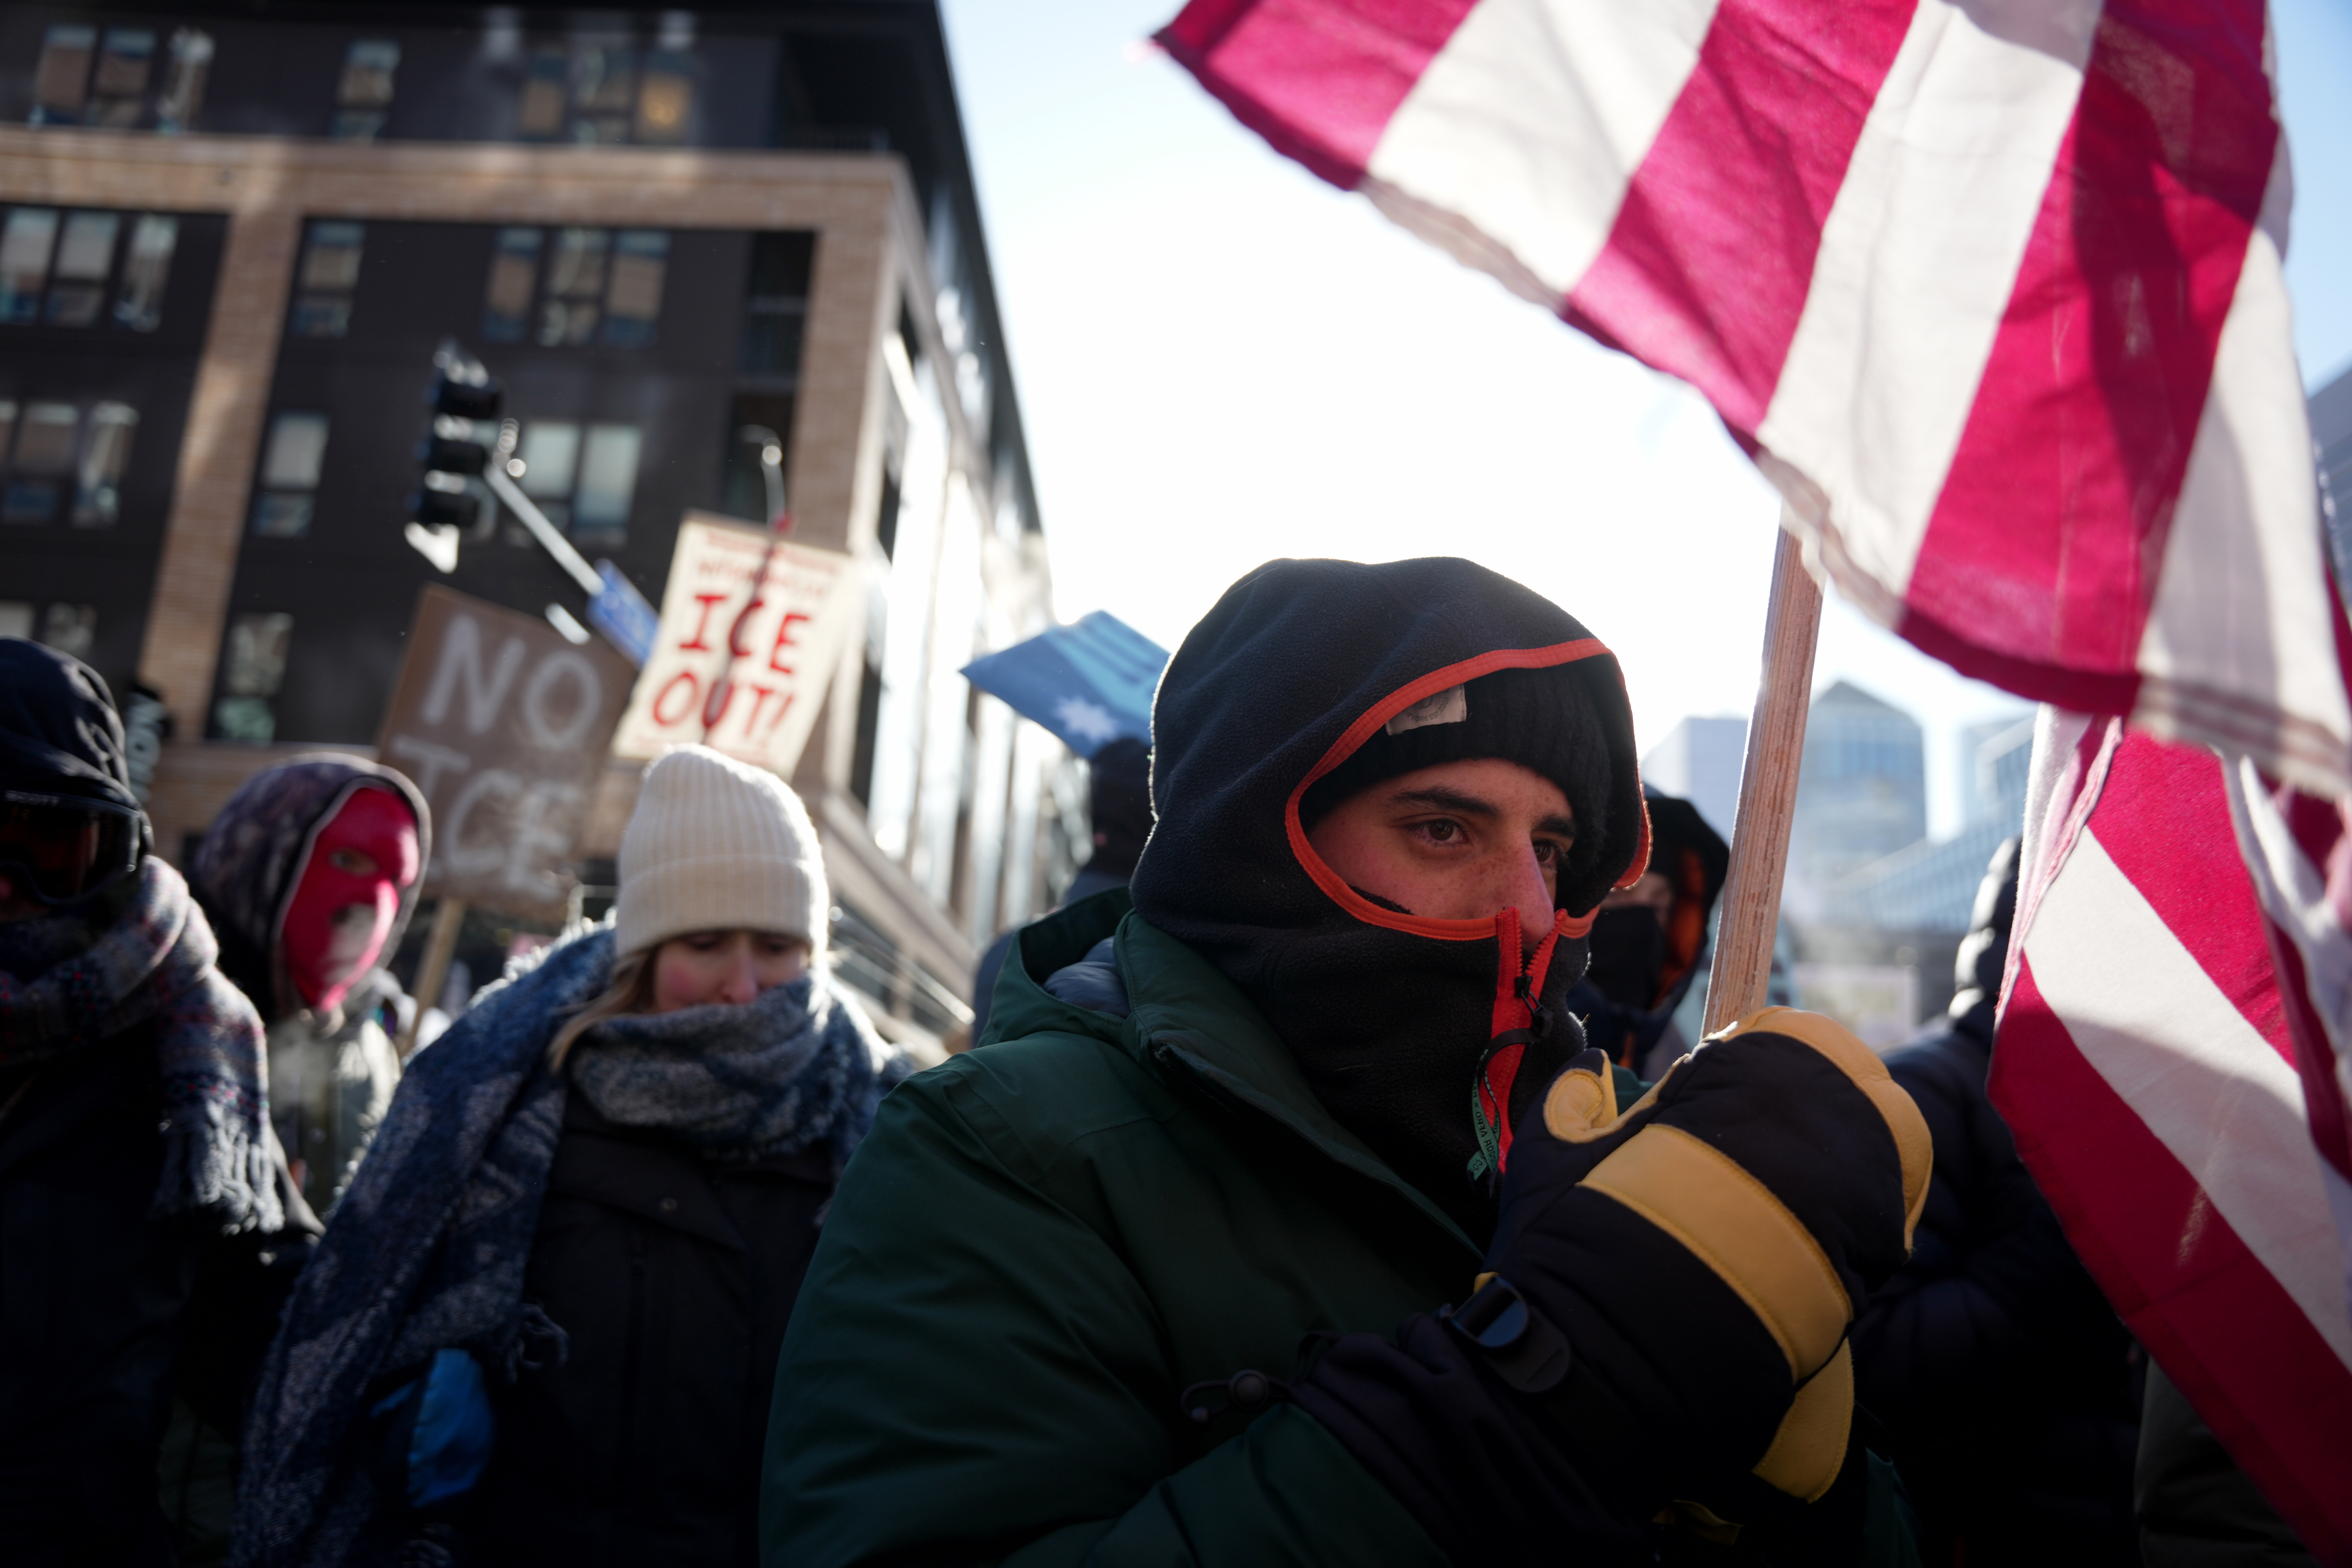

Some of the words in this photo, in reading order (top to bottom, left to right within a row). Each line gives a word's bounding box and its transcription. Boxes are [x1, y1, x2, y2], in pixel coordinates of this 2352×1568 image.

[421, 612, 603, 750] NO
[677, 592, 814, 675] ICE
[651, 671, 794, 745] OUT!
[391, 732, 581, 900] ICE
